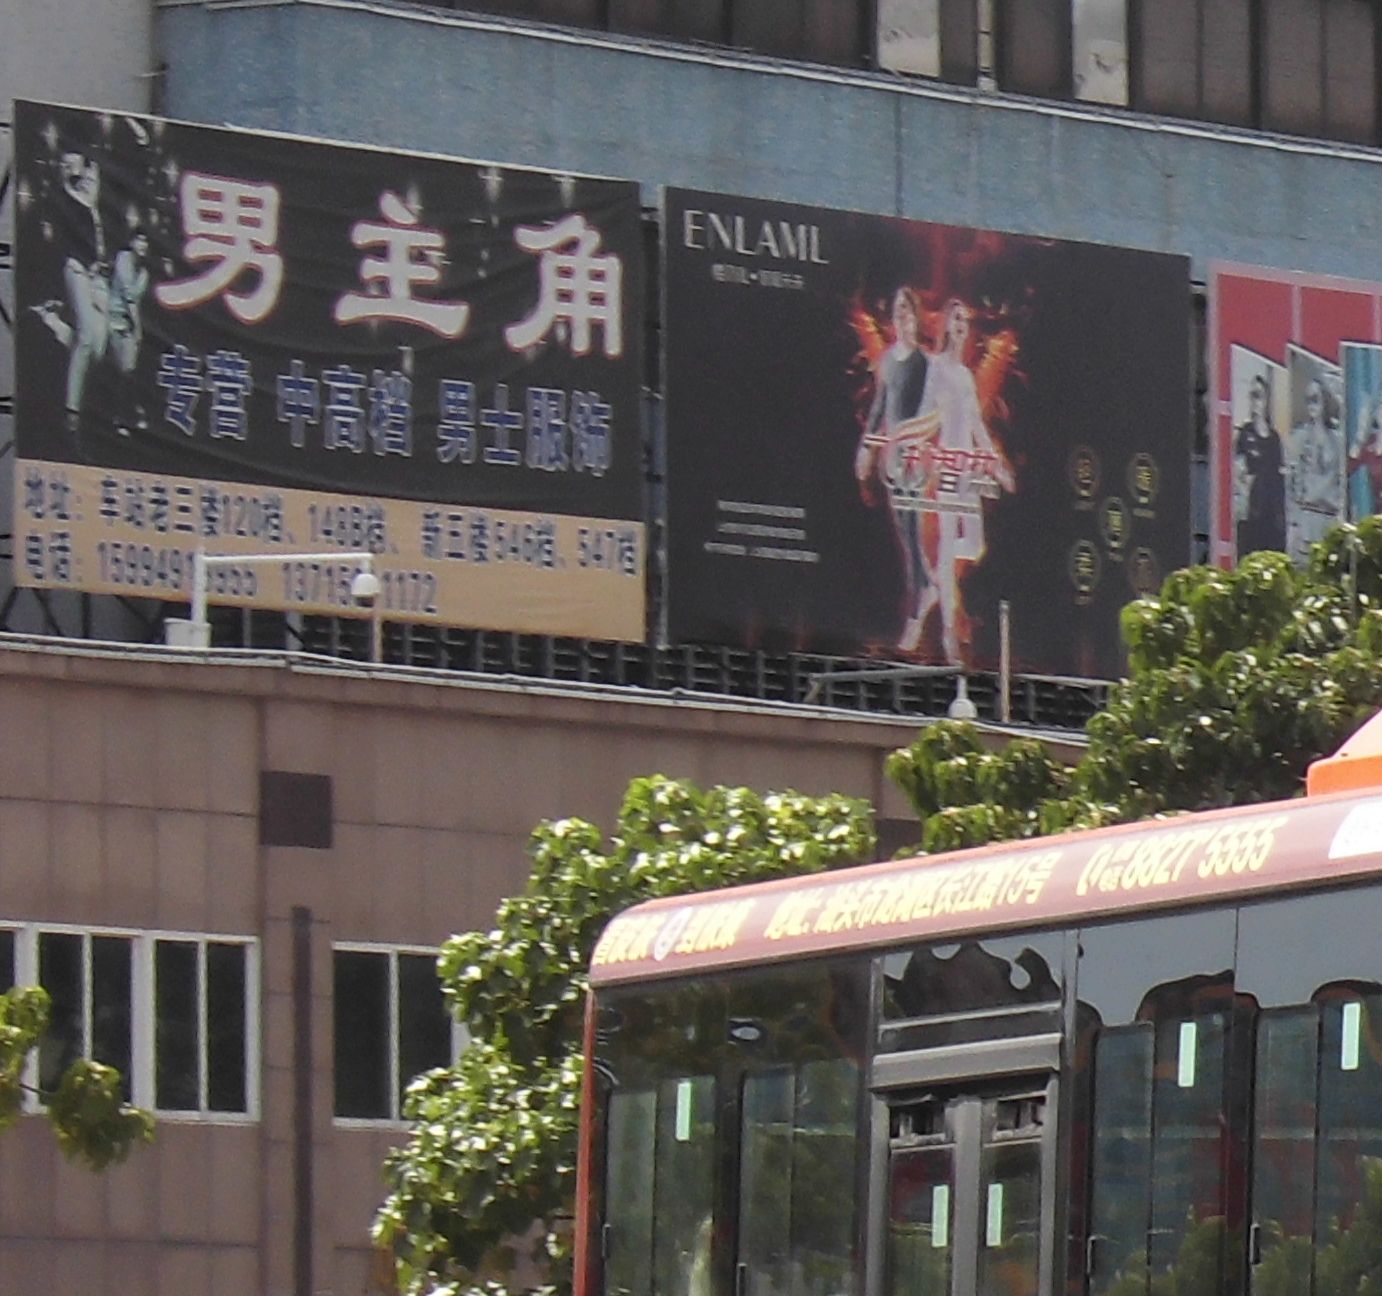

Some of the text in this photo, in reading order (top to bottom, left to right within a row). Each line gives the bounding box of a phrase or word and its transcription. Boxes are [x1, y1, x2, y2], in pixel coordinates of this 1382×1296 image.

[155, 172, 625, 358] 男主角
[158, 344, 252, 441] 专营
[437, 378, 613, 477] 男士服饰
